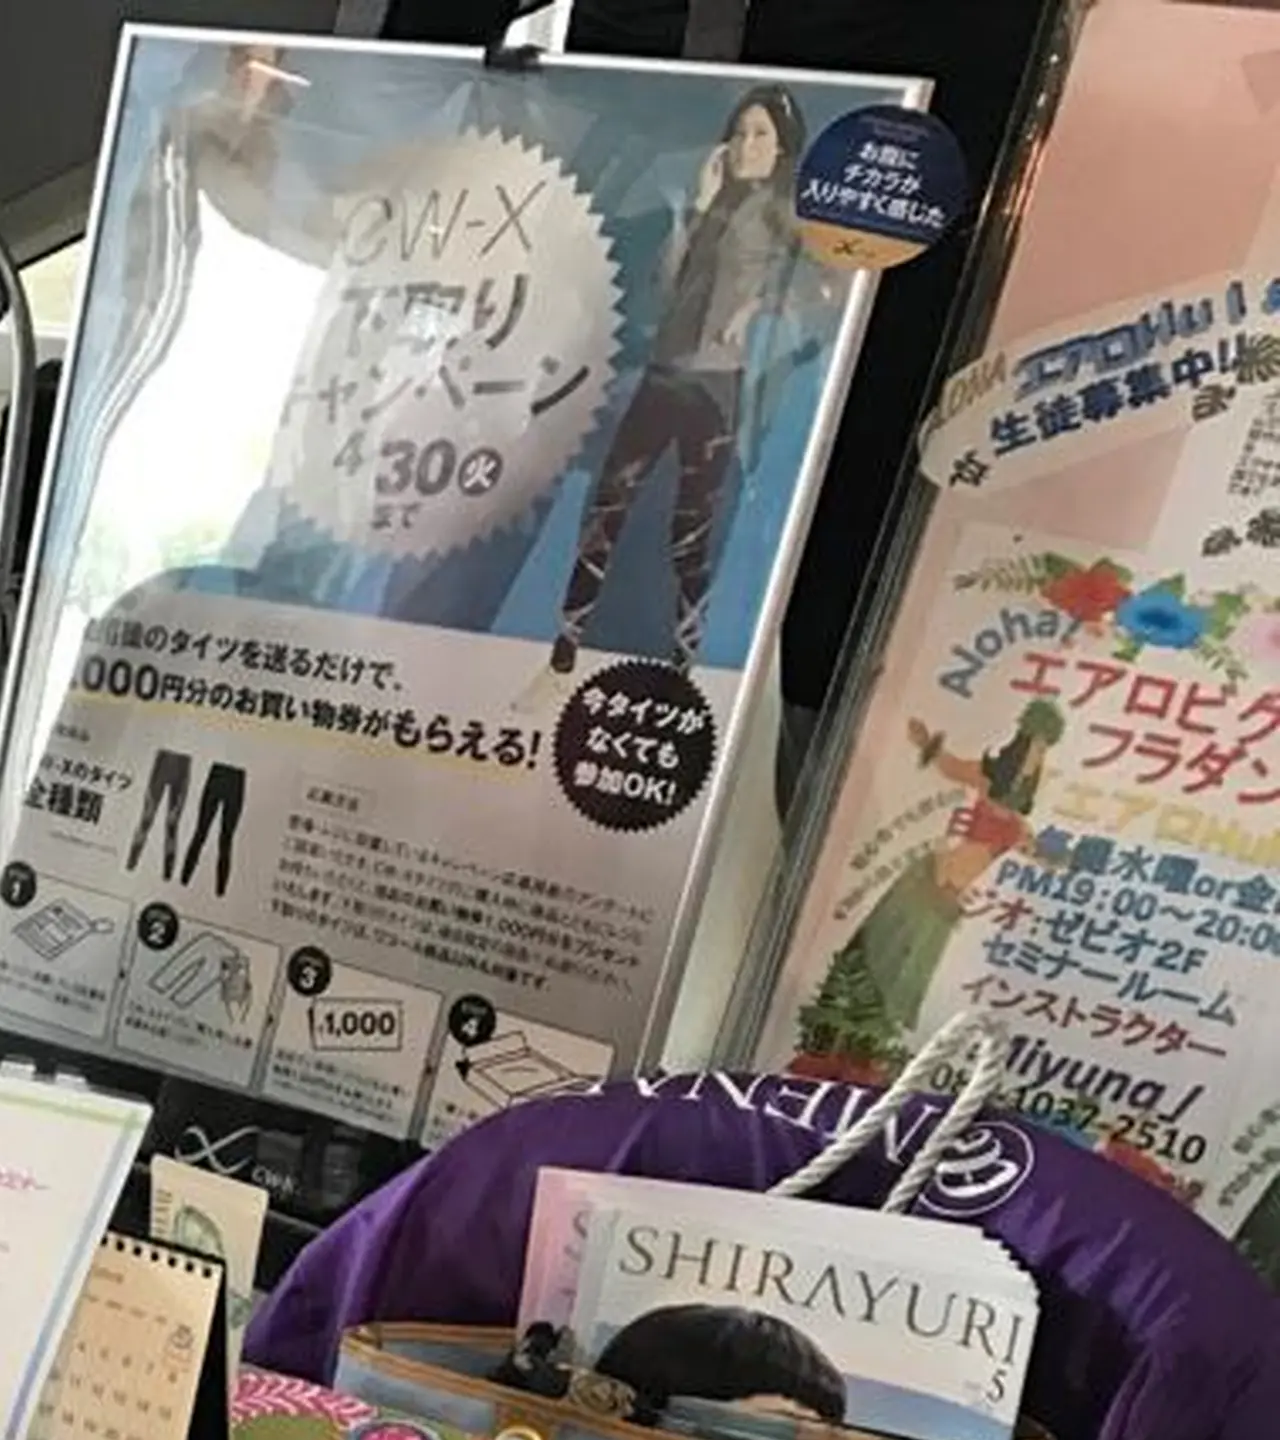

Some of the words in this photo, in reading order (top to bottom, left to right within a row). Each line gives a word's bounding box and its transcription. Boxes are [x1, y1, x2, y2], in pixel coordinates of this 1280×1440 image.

[342, 180, 547, 267] CW-X
[582, 687, 706, 735] 今タイツが
[588, 726, 680, 769] なくても
[574, 761, 677, 805] 参加OK!
[961, 974, 1227, 1058] インストラクター
[983, 933, 1237, 1028] セミナールーム
[929, 1063, 1208, 1164] 08-1037-2510
[618, 1225, 1025, 1367] SHIRAYURI
[984, 1369, 1009, 1403] 5
